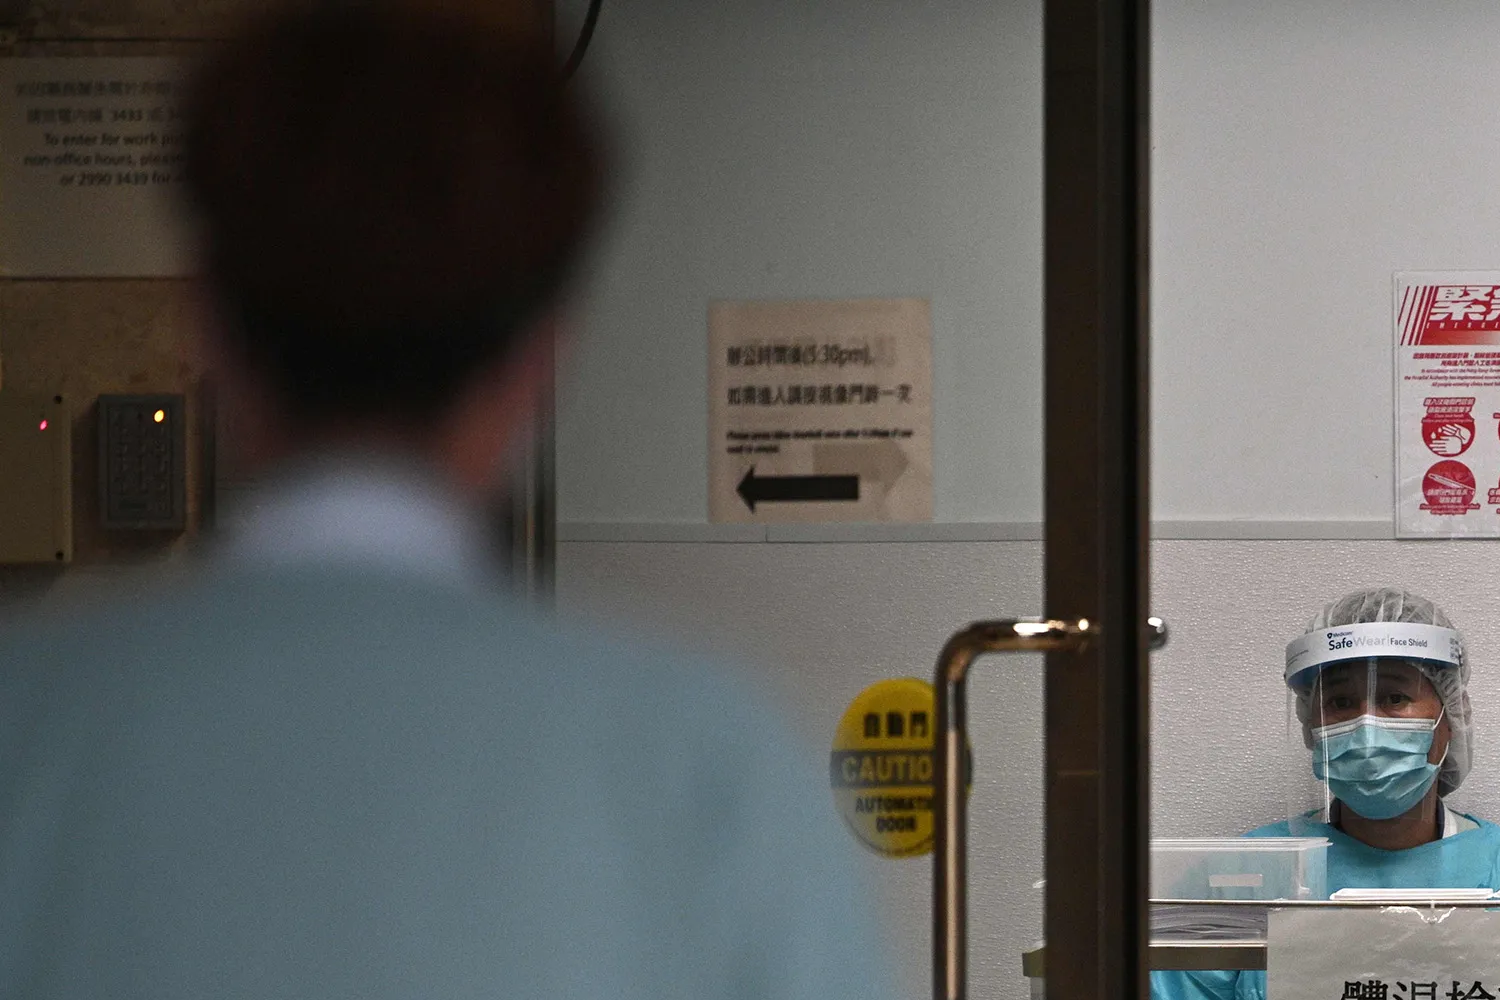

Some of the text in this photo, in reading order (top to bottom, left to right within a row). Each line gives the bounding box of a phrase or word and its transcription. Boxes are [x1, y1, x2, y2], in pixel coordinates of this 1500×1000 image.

[1390, 637, 1407, 646] Face
[1409, 638, 1428, 648] Shield
[841, 755, 934, 782] CAUTIO
